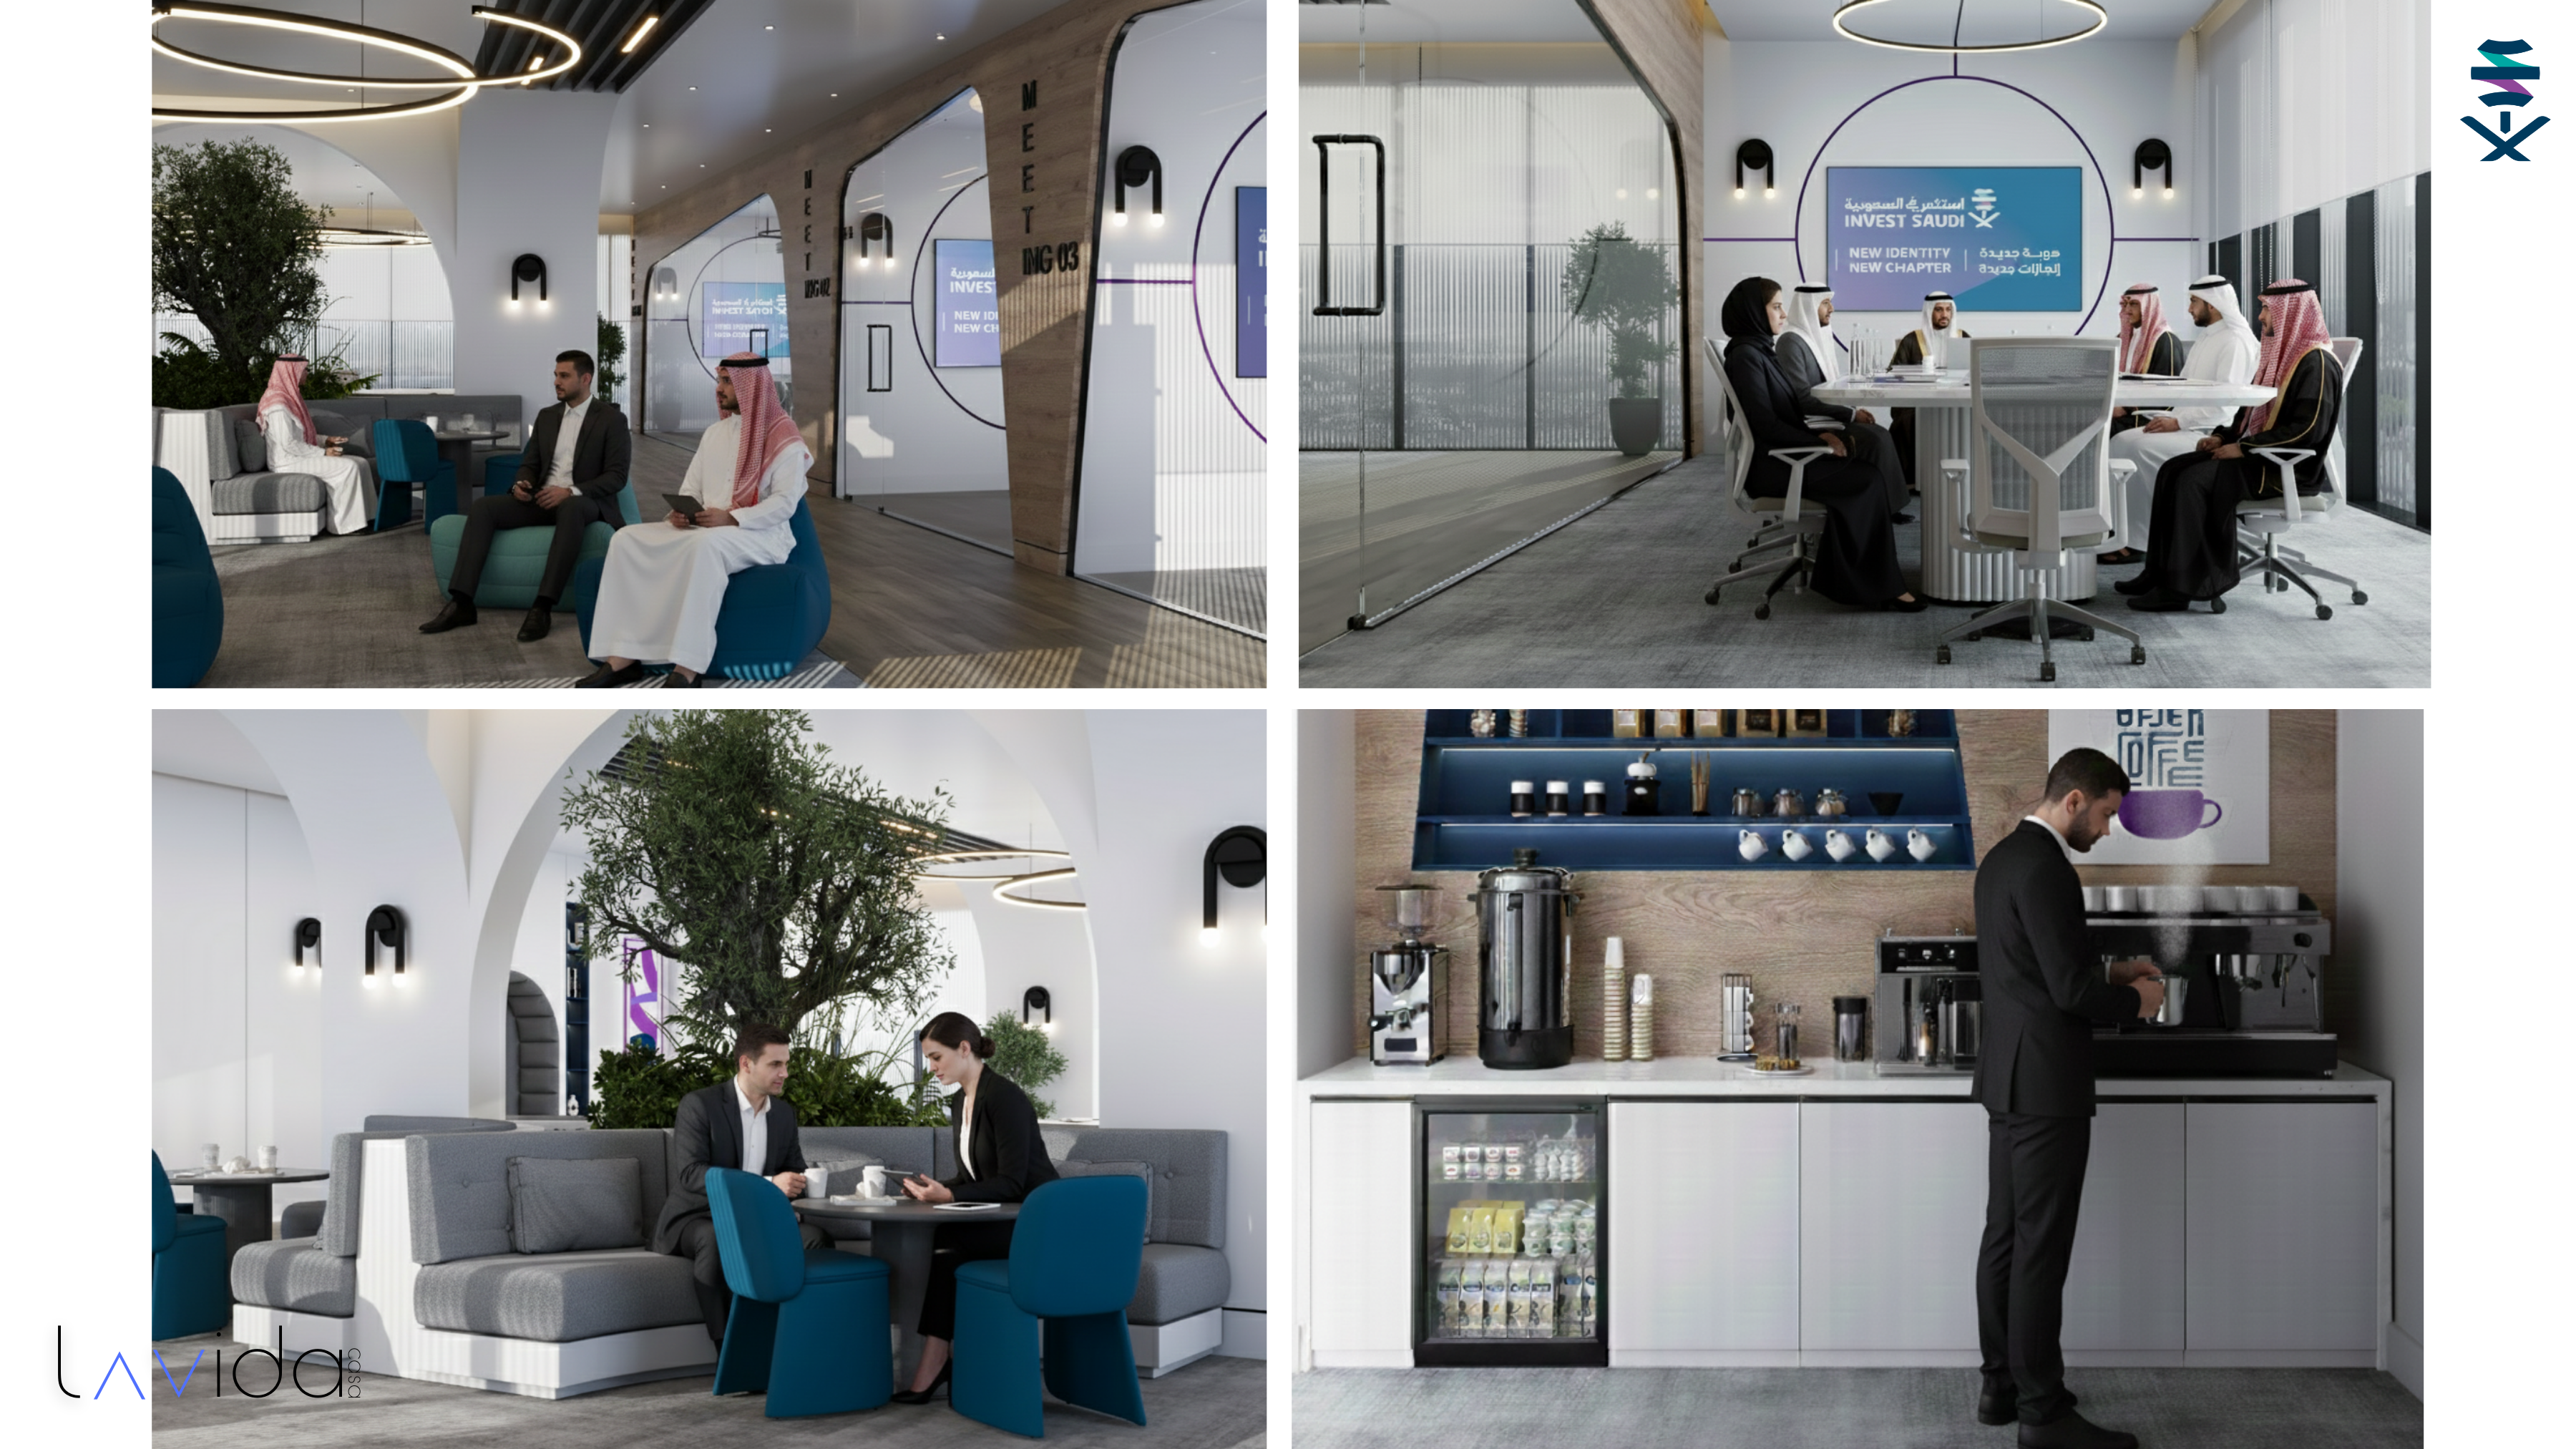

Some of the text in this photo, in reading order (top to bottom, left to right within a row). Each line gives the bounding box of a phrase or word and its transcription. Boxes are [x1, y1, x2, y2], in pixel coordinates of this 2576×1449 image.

[1845, 214, 1965, 228] INVEST SAUDI
[1022, 241, 1078, 275] ING 03
[1849, 248, 1951, 258] NEW IDENTITY
[1849, 262, 1951, 273] NEW CHAPTER
[954, 311, 980, 321] NEW
[954, 323, 980, 333] NEW
